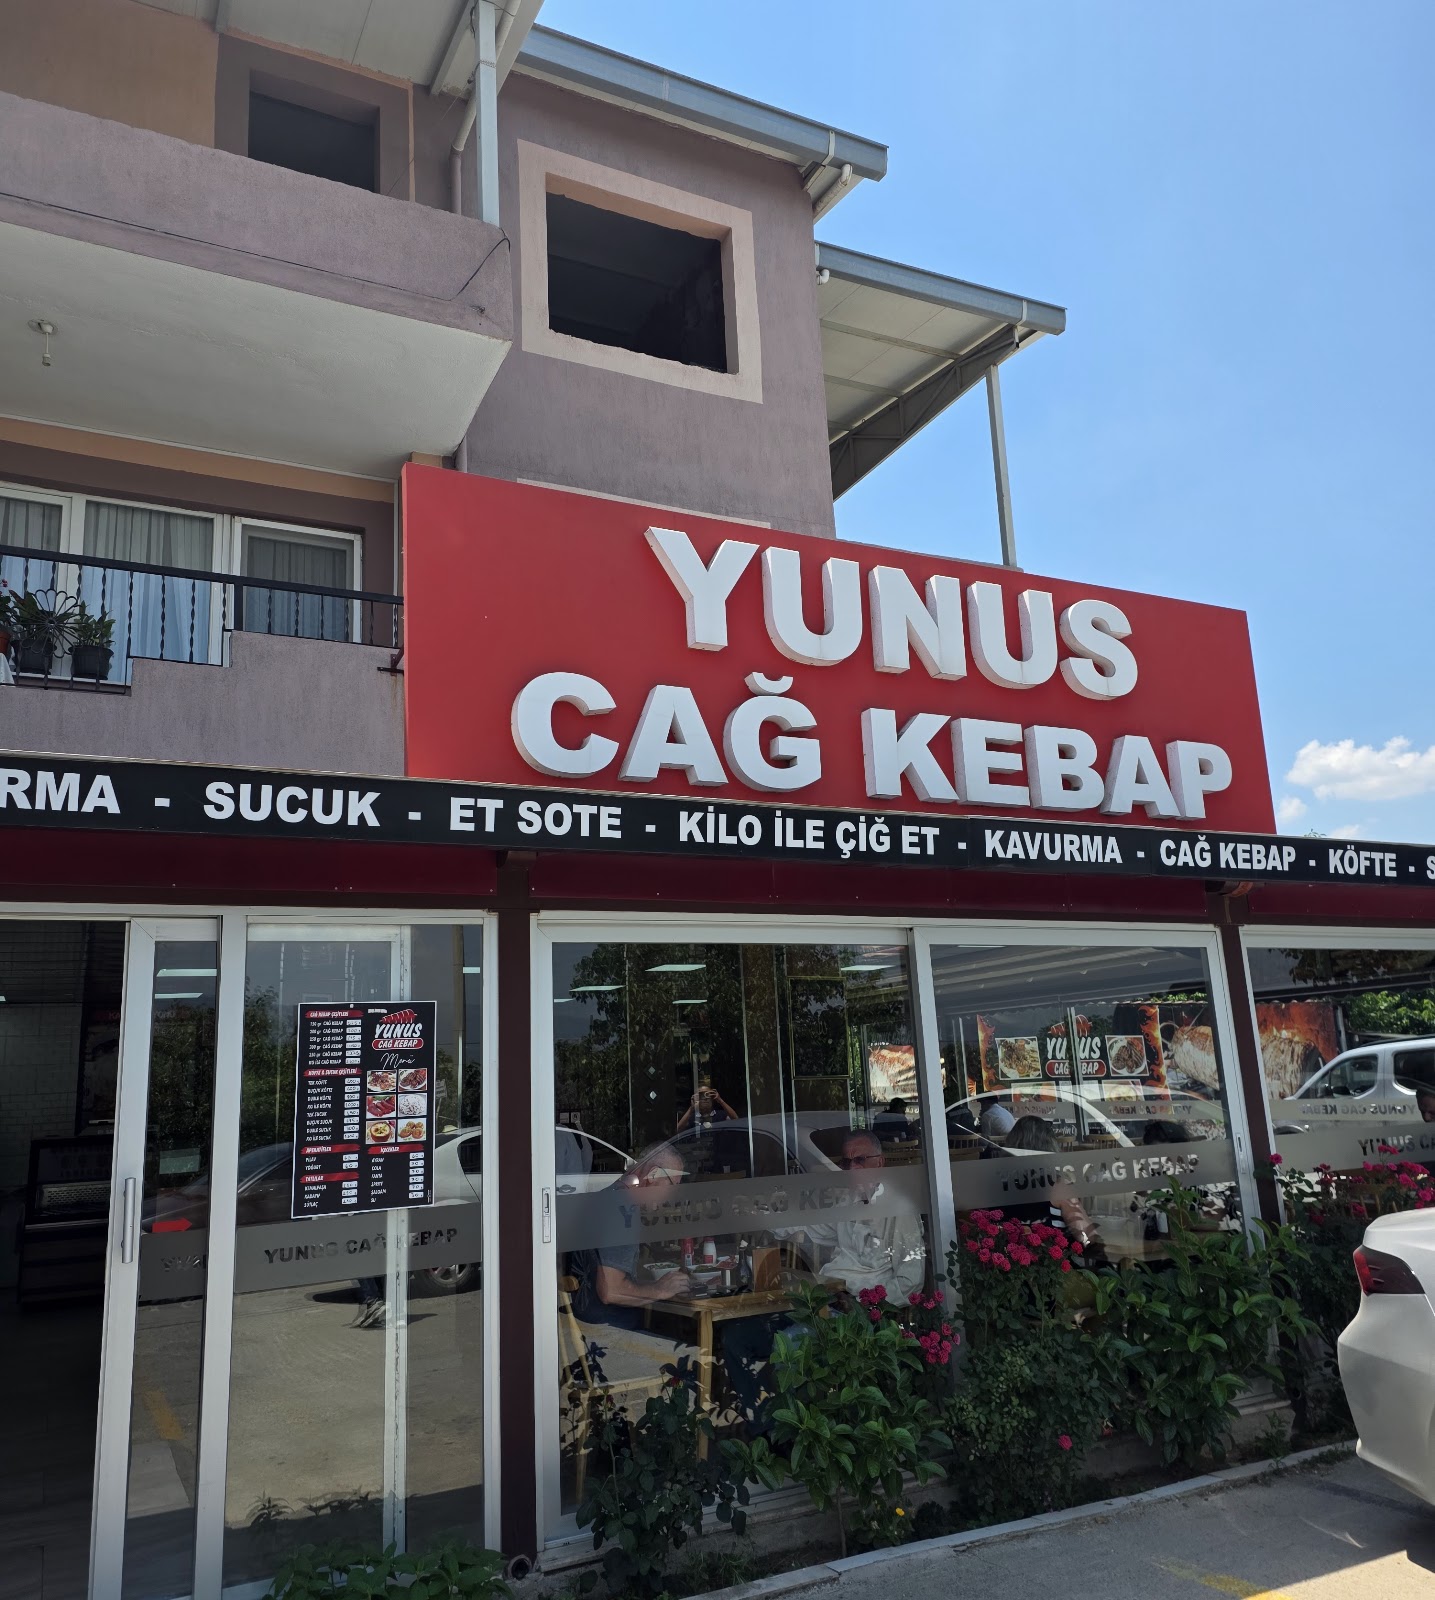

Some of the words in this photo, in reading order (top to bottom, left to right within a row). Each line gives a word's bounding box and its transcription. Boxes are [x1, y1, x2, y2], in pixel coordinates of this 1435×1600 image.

[644, 526, 1138, 700] YUNUS
[511, 671, 821, 792] CAĞ
[861, 708, 1232, 820] KEBAP
[203, 781, 381, 827] SUCUK
[449, 796, 504, 833] ET
[517, 800, 622, 839] SOTE
[679, 805, 762, 846] KİLO
[774, 809, 825, 850] İLE
[835, 815, 891, 859] ÇİĞ
[901, 824, 940, 855] ET
[984, 829, 1123, 864] KAVURMA
[1159, 835, 1212, 868] CAĞ
[1219, 842, 1296, 872] KEBAP
[1328, 842, 1397, 878] KÖFTE
[374, 1022, 422, 1039] YUNUS
[394, 1039, 418, 1048] KEBAP
[1046, 1036, 1102, 1060] YUUS
[1132, 1154, 1200, 1179] KEBAP
[264, 1241, 339, 1264] YUNUS
